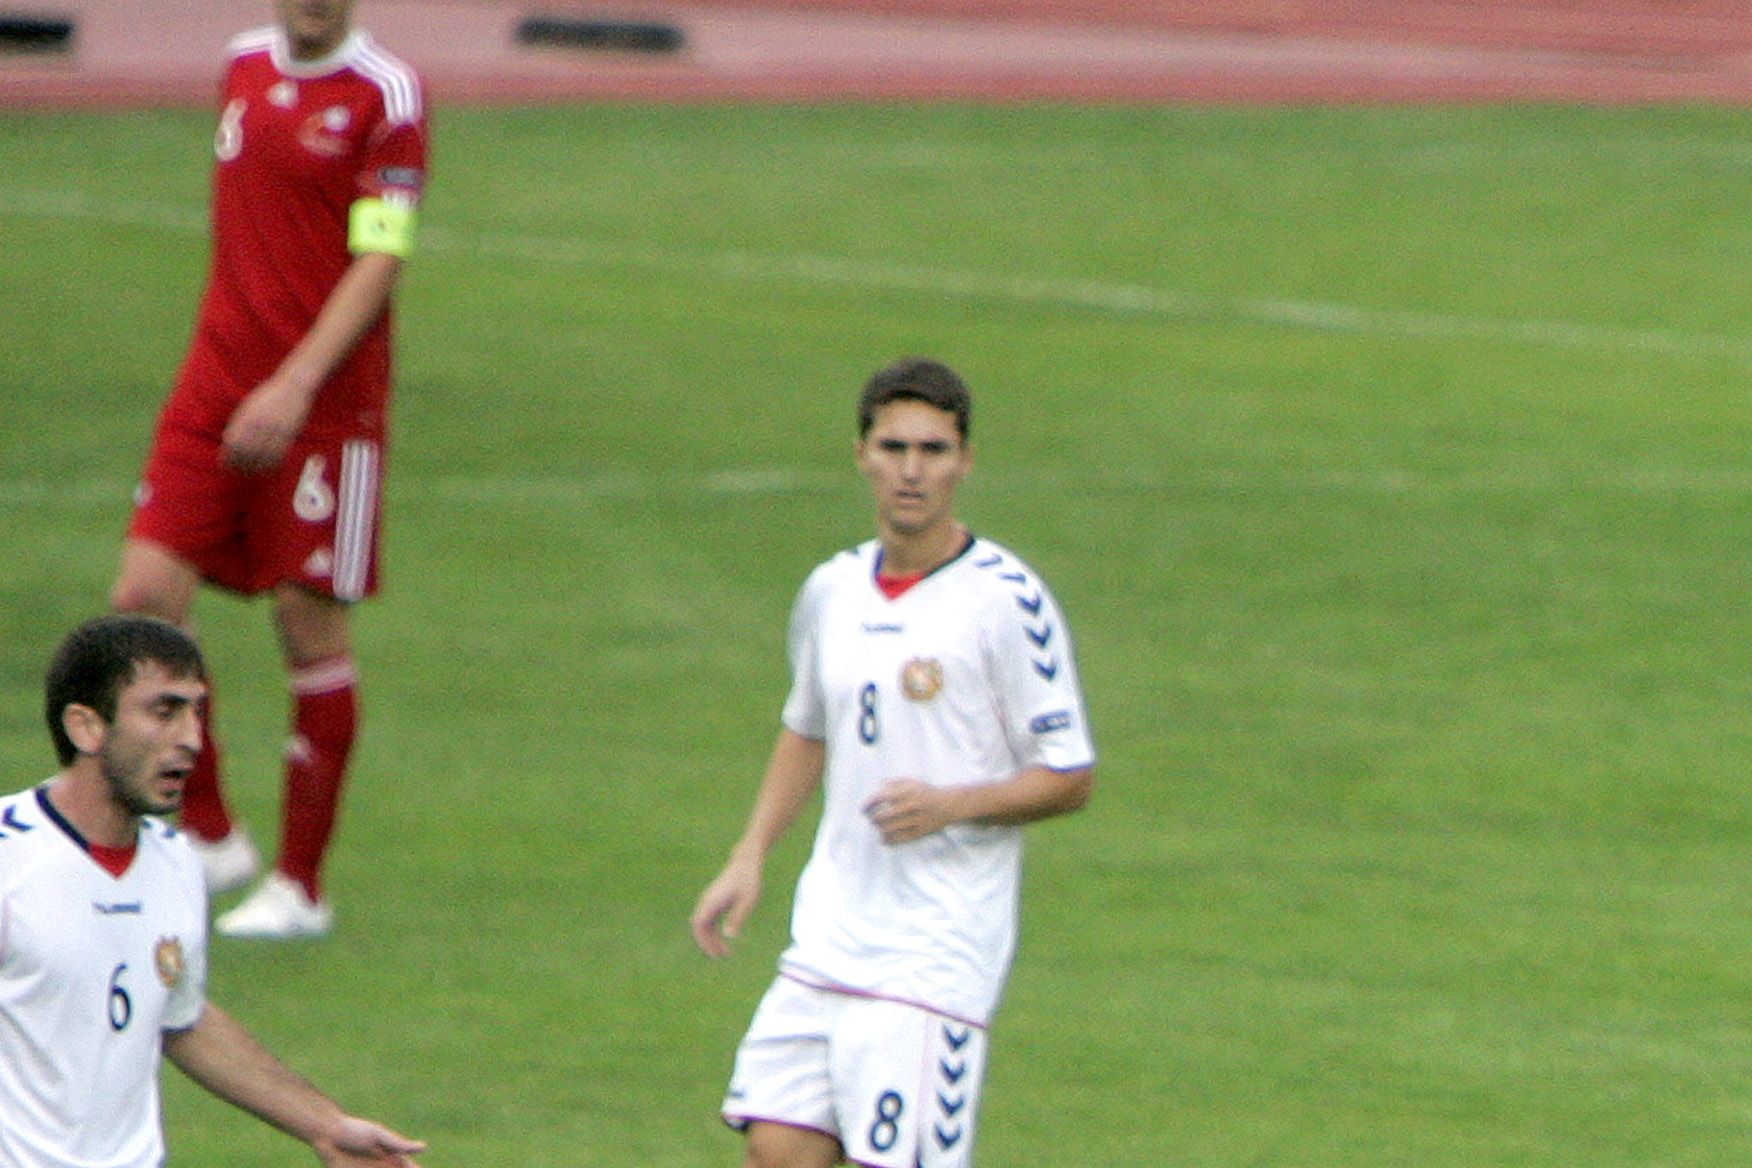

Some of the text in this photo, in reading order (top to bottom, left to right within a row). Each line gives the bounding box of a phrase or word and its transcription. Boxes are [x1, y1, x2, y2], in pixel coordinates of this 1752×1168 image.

[293, 453, 335, 521] 6
[860, 682, 878, 744] 8
[108, 963, 131, 1031] 6
[870, 1089, 902, 1152] 8
